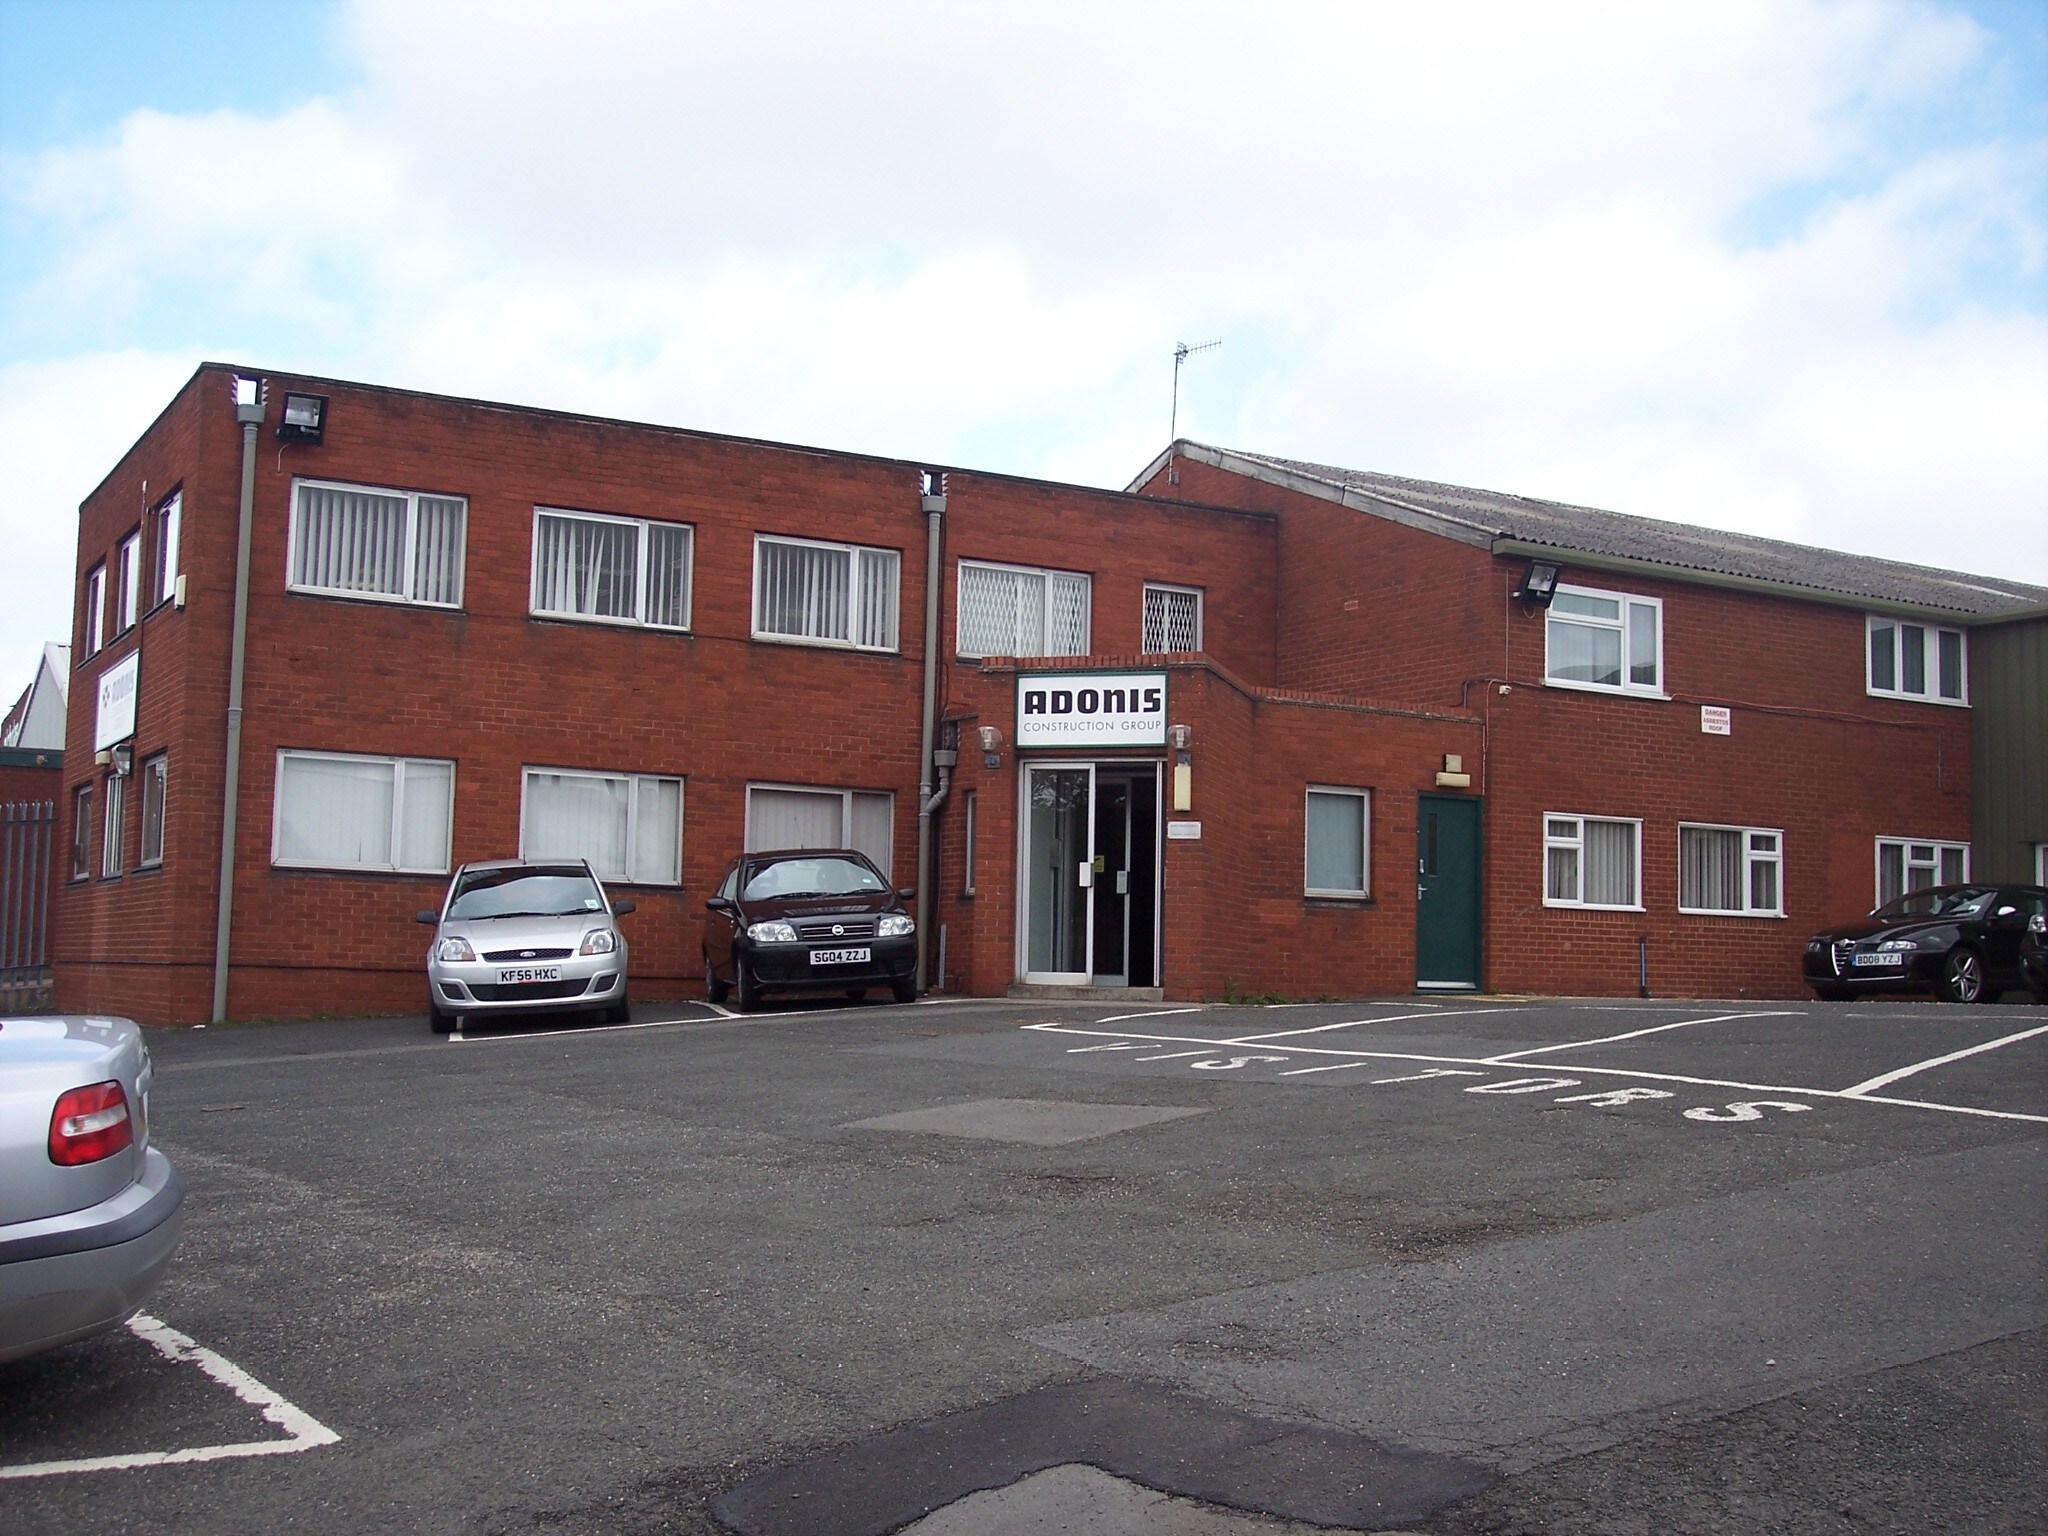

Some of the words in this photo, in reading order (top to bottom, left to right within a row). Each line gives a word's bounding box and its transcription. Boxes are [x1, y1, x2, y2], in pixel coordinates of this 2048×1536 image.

[1024, 688, 1161, 714] ADONIS
[1705, 709, 1727, 717] DANGER
[1024, 721, 1114, 732] CONSTRUCTION
[1121, 720, 1161, 730] GROUP
[814, 951, 843, 963] SG04
[845, 950, 867, 961] ZZJ
[1882, 954, 1900, 963] YZJ
[501, 969, 532, 982] KF56
[534, 968, 558, 980] HXC
